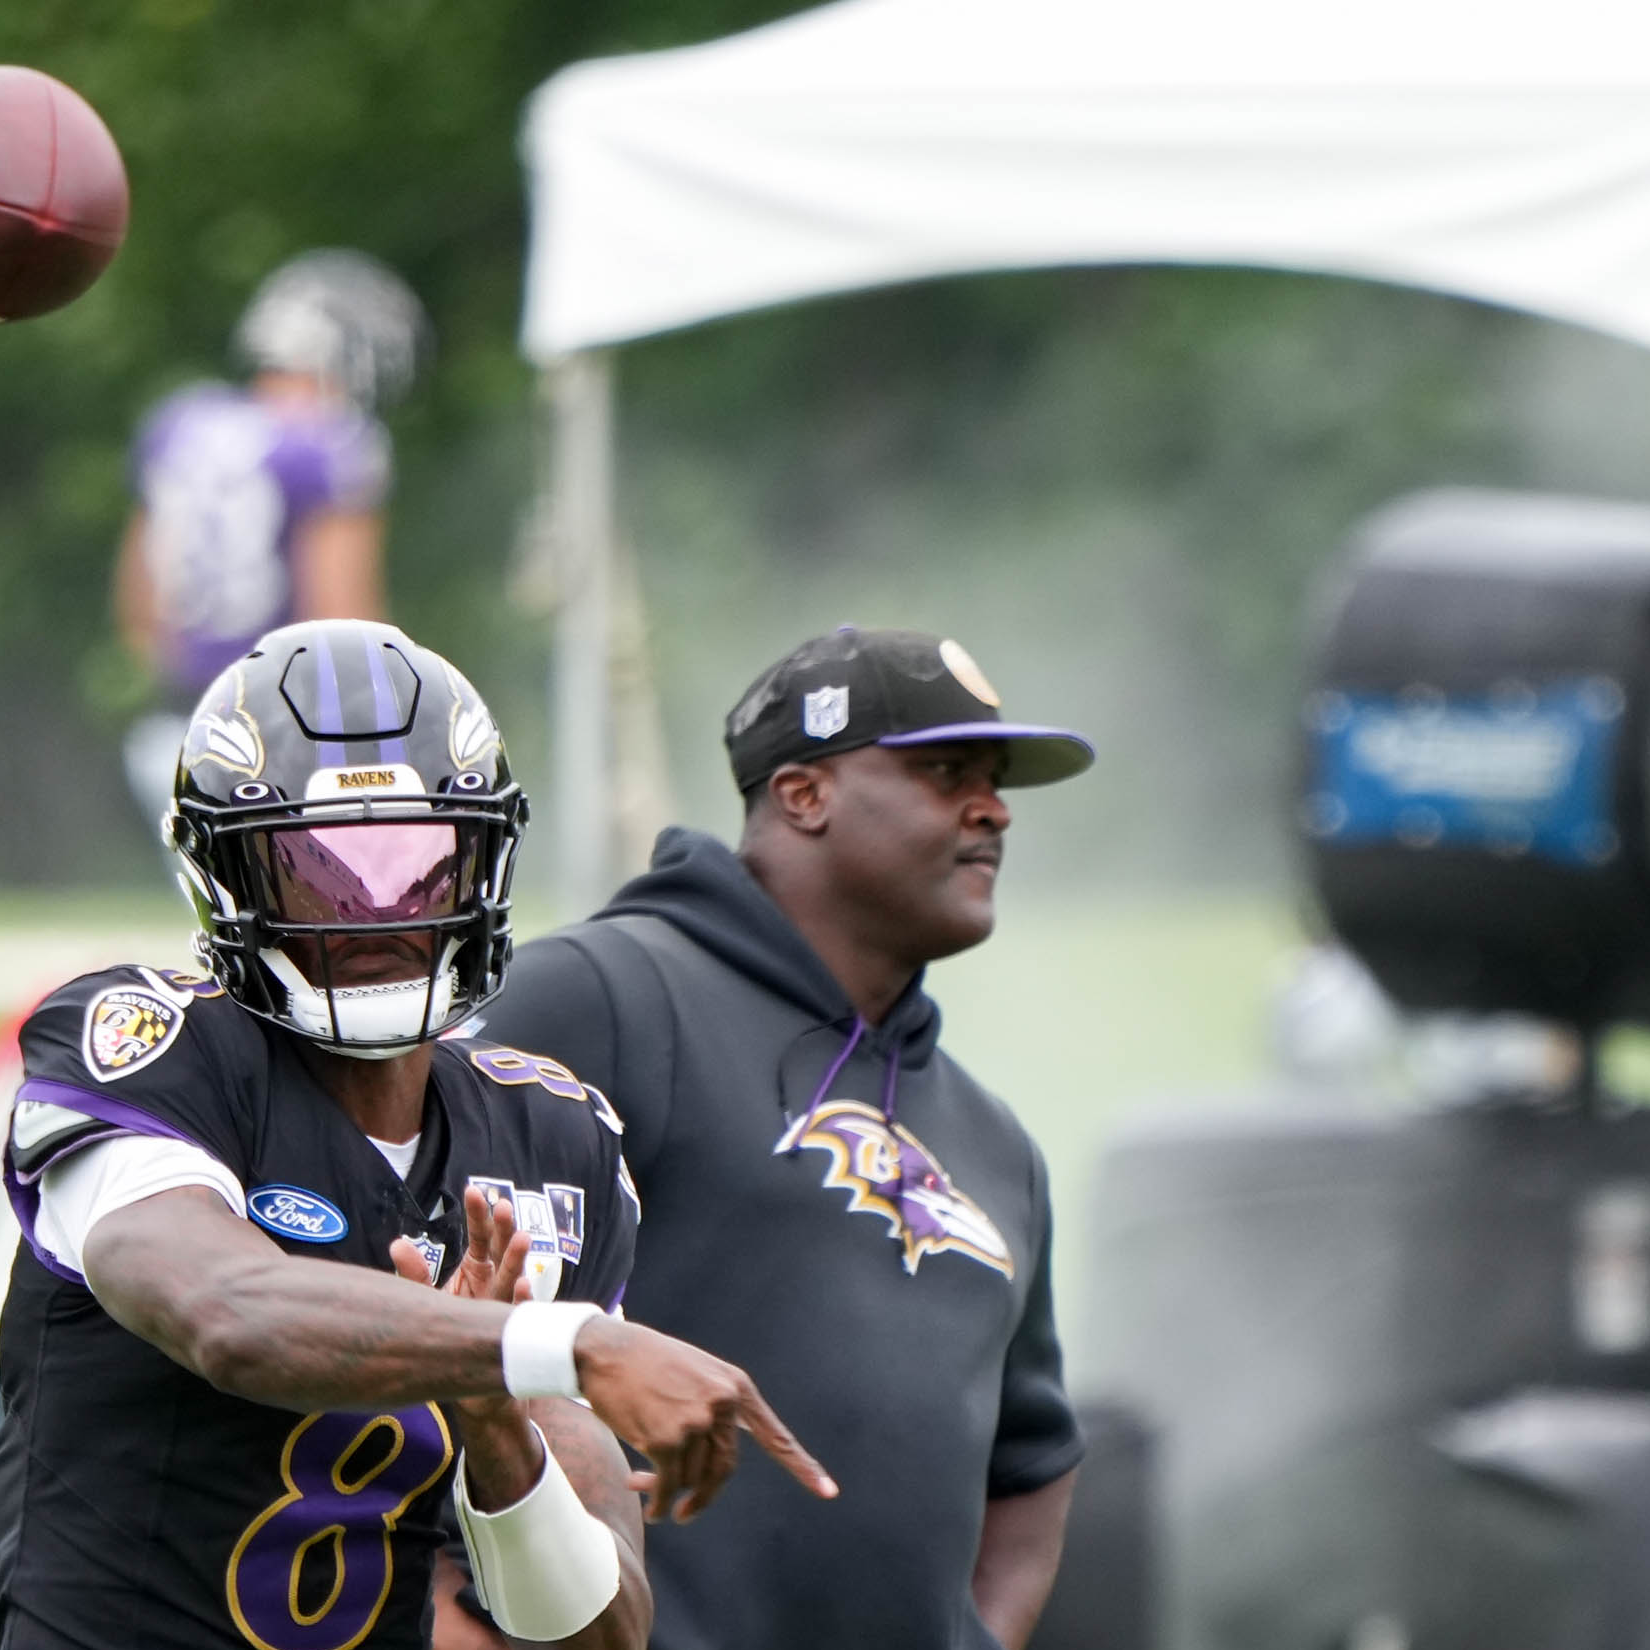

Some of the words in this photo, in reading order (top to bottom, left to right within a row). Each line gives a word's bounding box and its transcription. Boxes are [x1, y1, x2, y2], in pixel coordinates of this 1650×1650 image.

[336, 770, 396, 789] RAVENS
[106, 993, 173, 1022] RAVENS
[469, 1047, 589, 1102] 8
[264, 1194, 328, 1233] Ford
